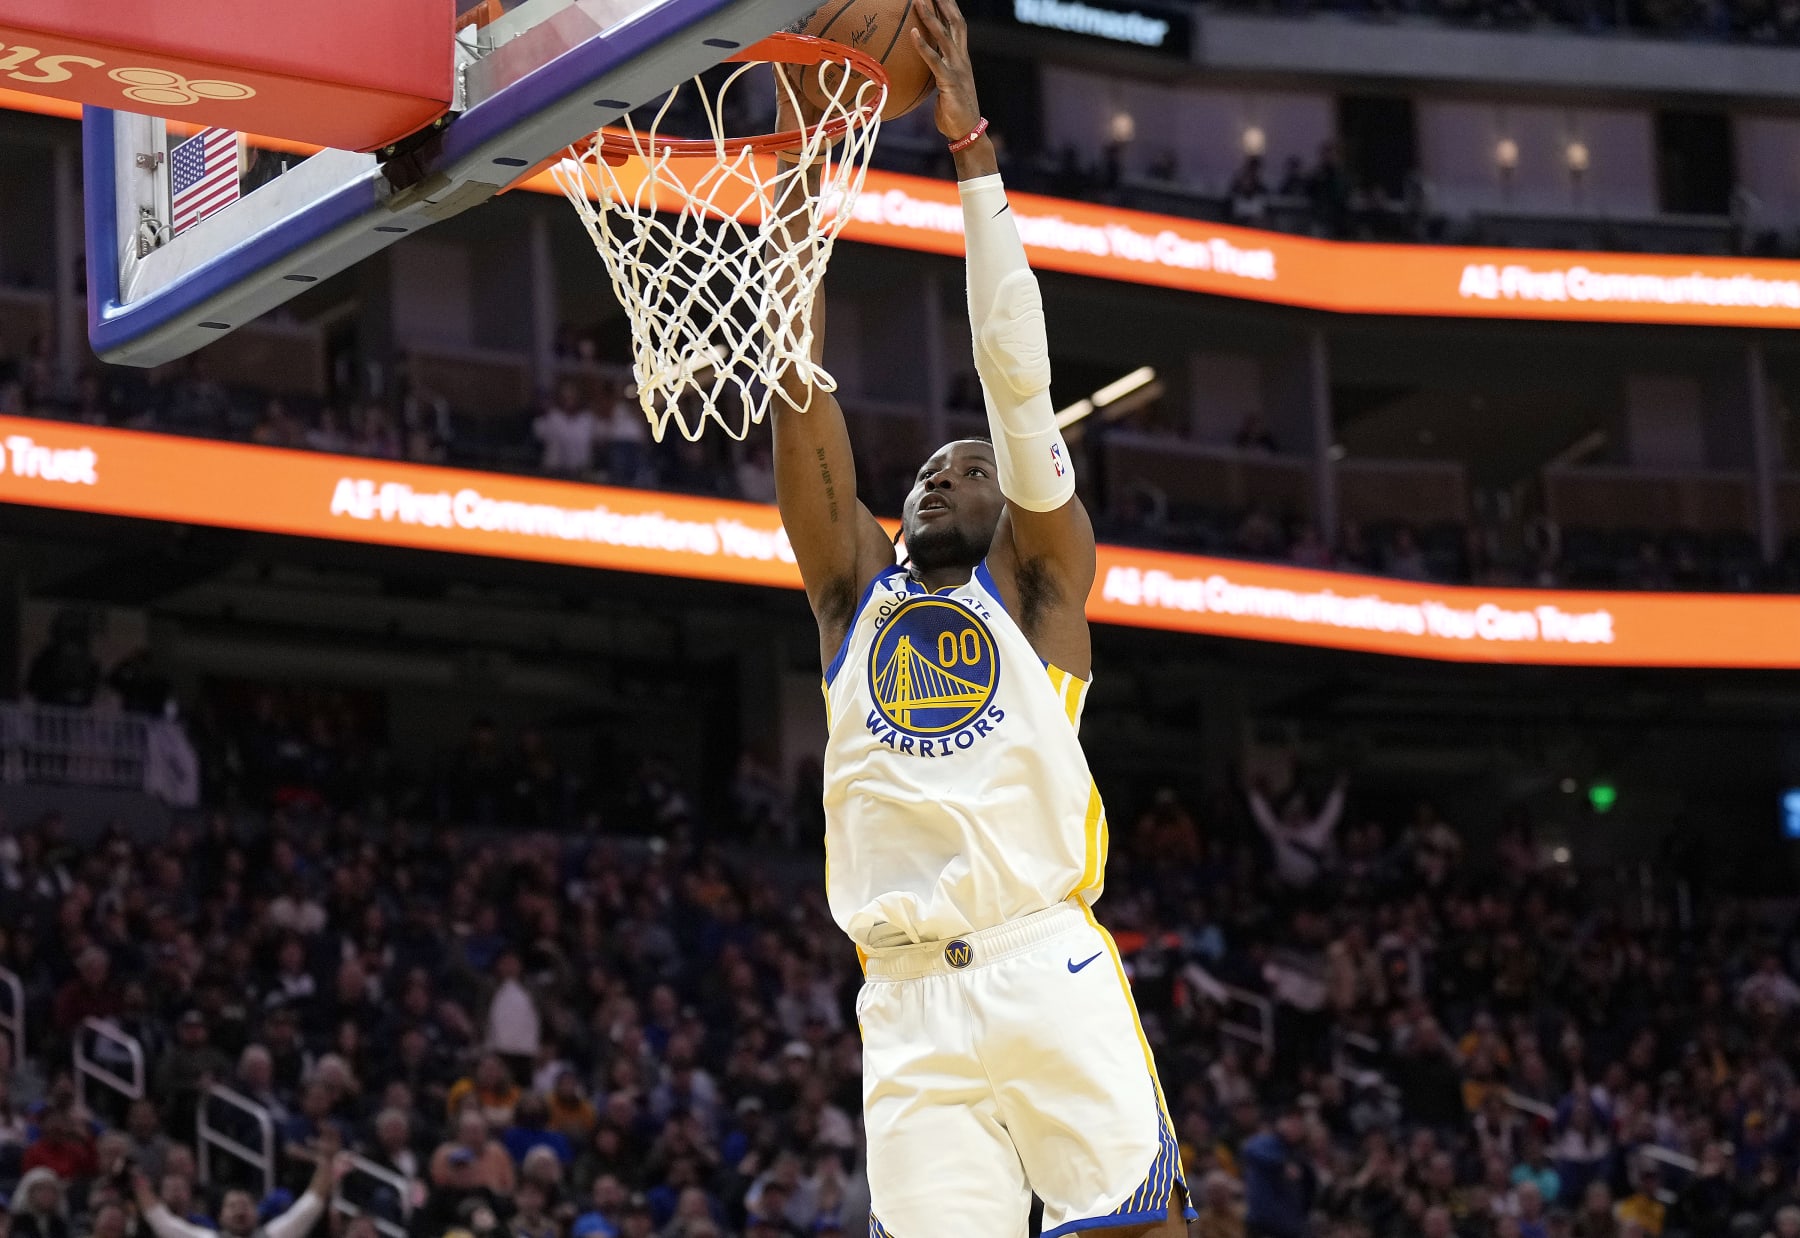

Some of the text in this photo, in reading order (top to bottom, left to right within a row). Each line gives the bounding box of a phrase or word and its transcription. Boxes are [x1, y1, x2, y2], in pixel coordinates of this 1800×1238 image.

[0, 42, 106, 83] St
[1156, 229, 1212, 271] Can
[1207, 237, 1277, 282] Trust
[5, 434, 98, 485] Trust
[453, 488, 718, 556] Communications
[1205, 574, 1426, 636] Communications
[1475, 602, 1538, 641] Can
[1535, 605, 1614, 644] Trust
[937, 628, 982, 669] 00
[865, 704, 1005, 758] WARRIORS
[946, 945, 969, 966] W
